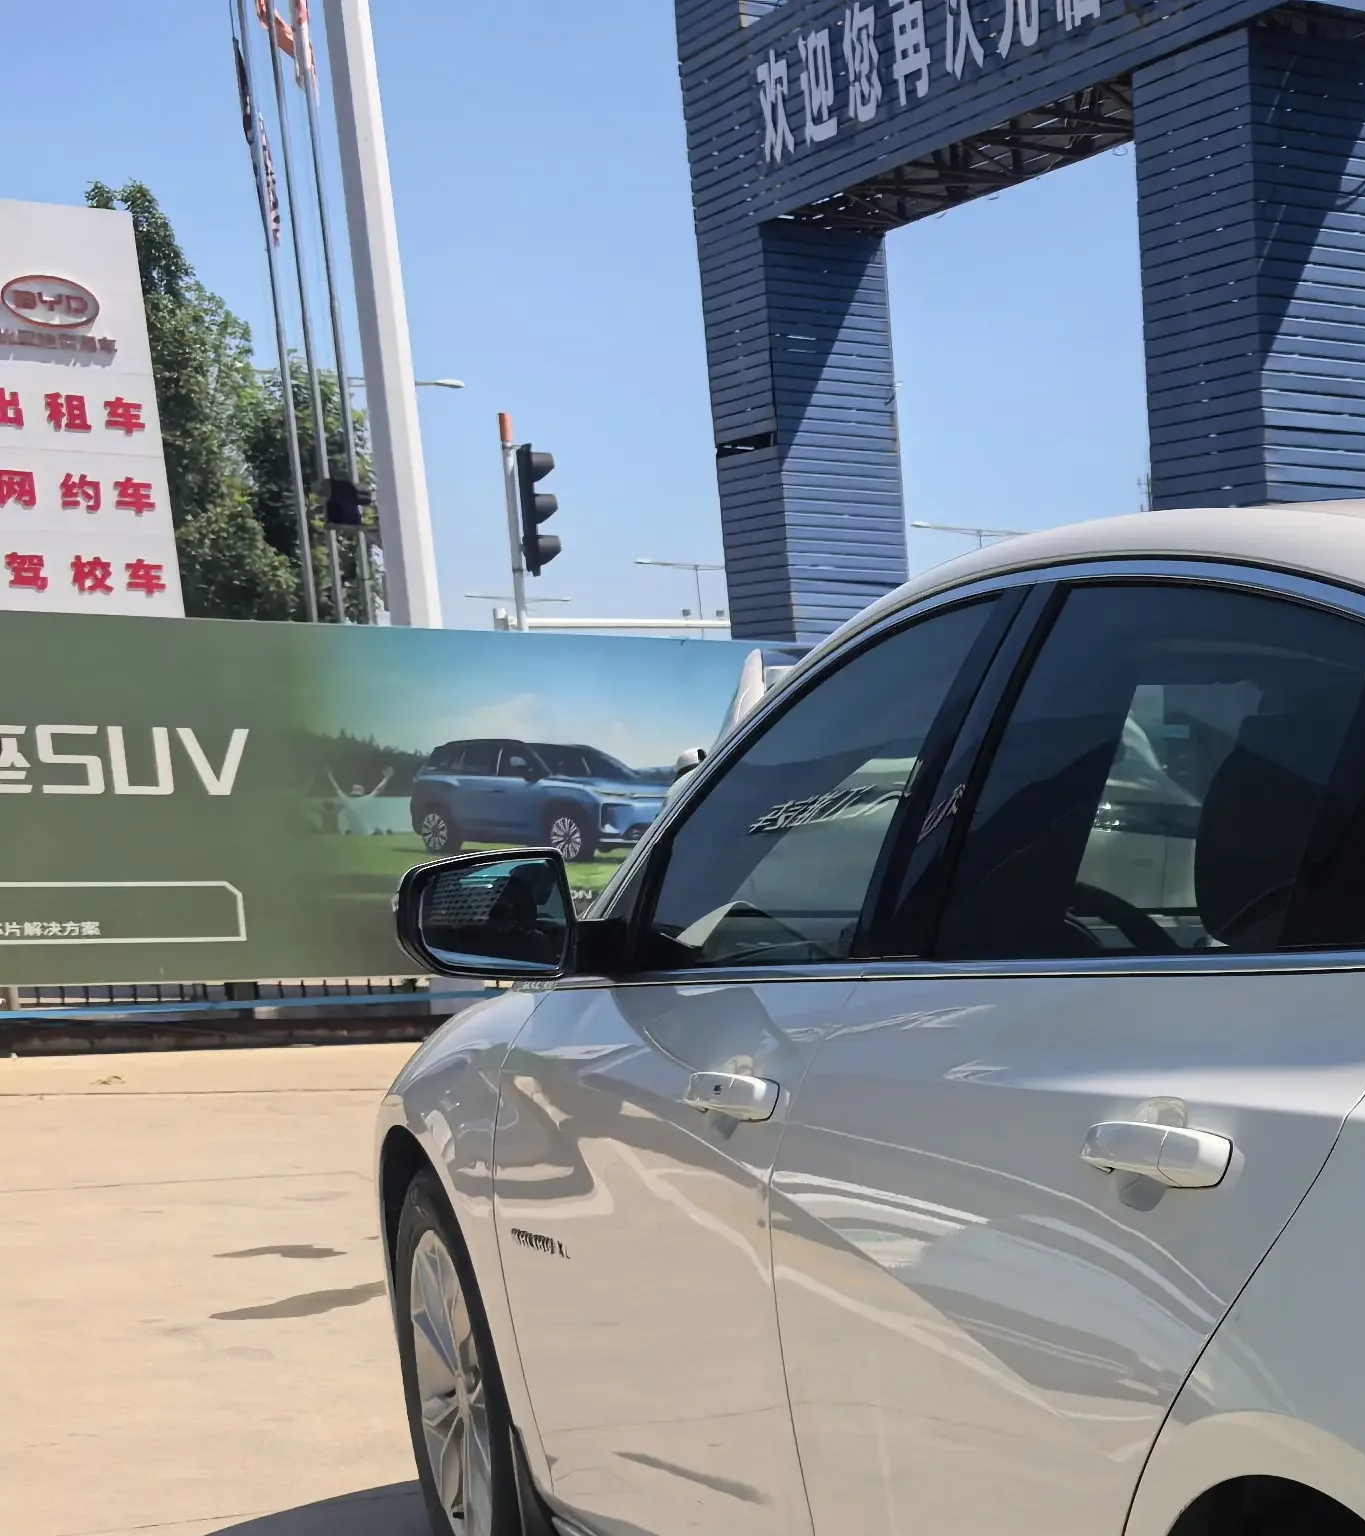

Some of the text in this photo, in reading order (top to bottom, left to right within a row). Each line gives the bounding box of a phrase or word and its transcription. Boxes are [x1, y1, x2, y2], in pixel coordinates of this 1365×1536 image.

[756, 0, 1101, 163] 欢迎您再次
[12, 289, 88, 314] BYD
[0, 469, 156, 515] 网约车
[5, 552, 166, 596] 驾校车
[0, 921, 101, 936] 片解决方案
